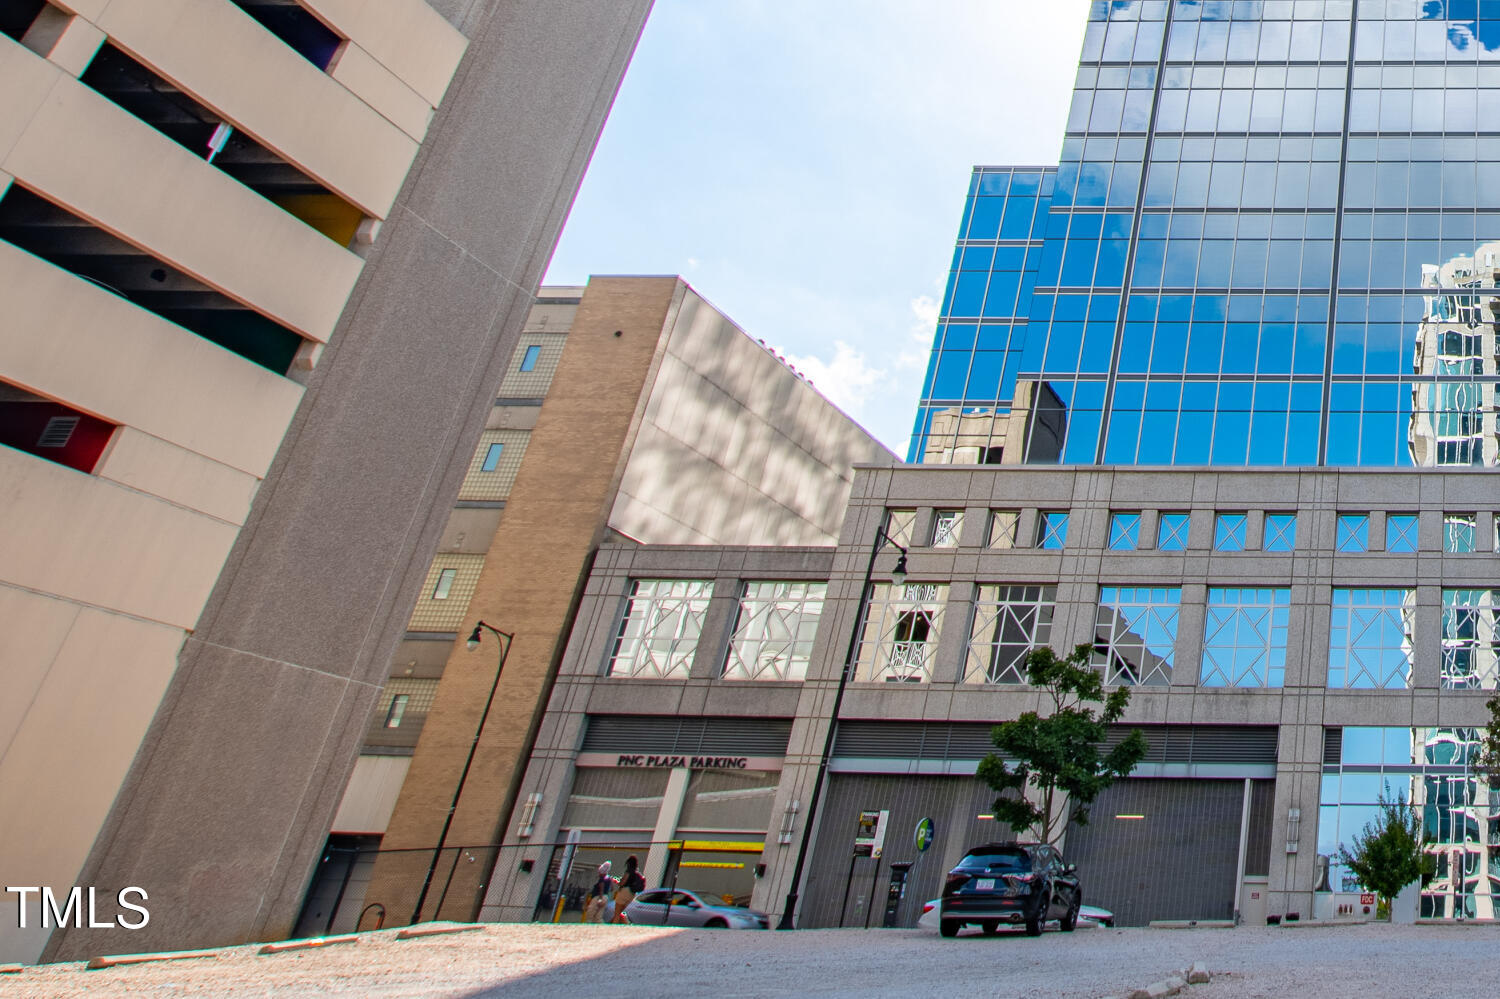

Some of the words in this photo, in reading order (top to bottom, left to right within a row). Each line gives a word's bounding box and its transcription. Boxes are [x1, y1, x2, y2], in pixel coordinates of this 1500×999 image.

[617, 755, 644, 767] PNC
[646, 756, 686, 768] PLAZA
[690, 756, 747, 769] PARKING
[918, 828, 925, 841] P
[1361, 895, 1374, 904] FDC
